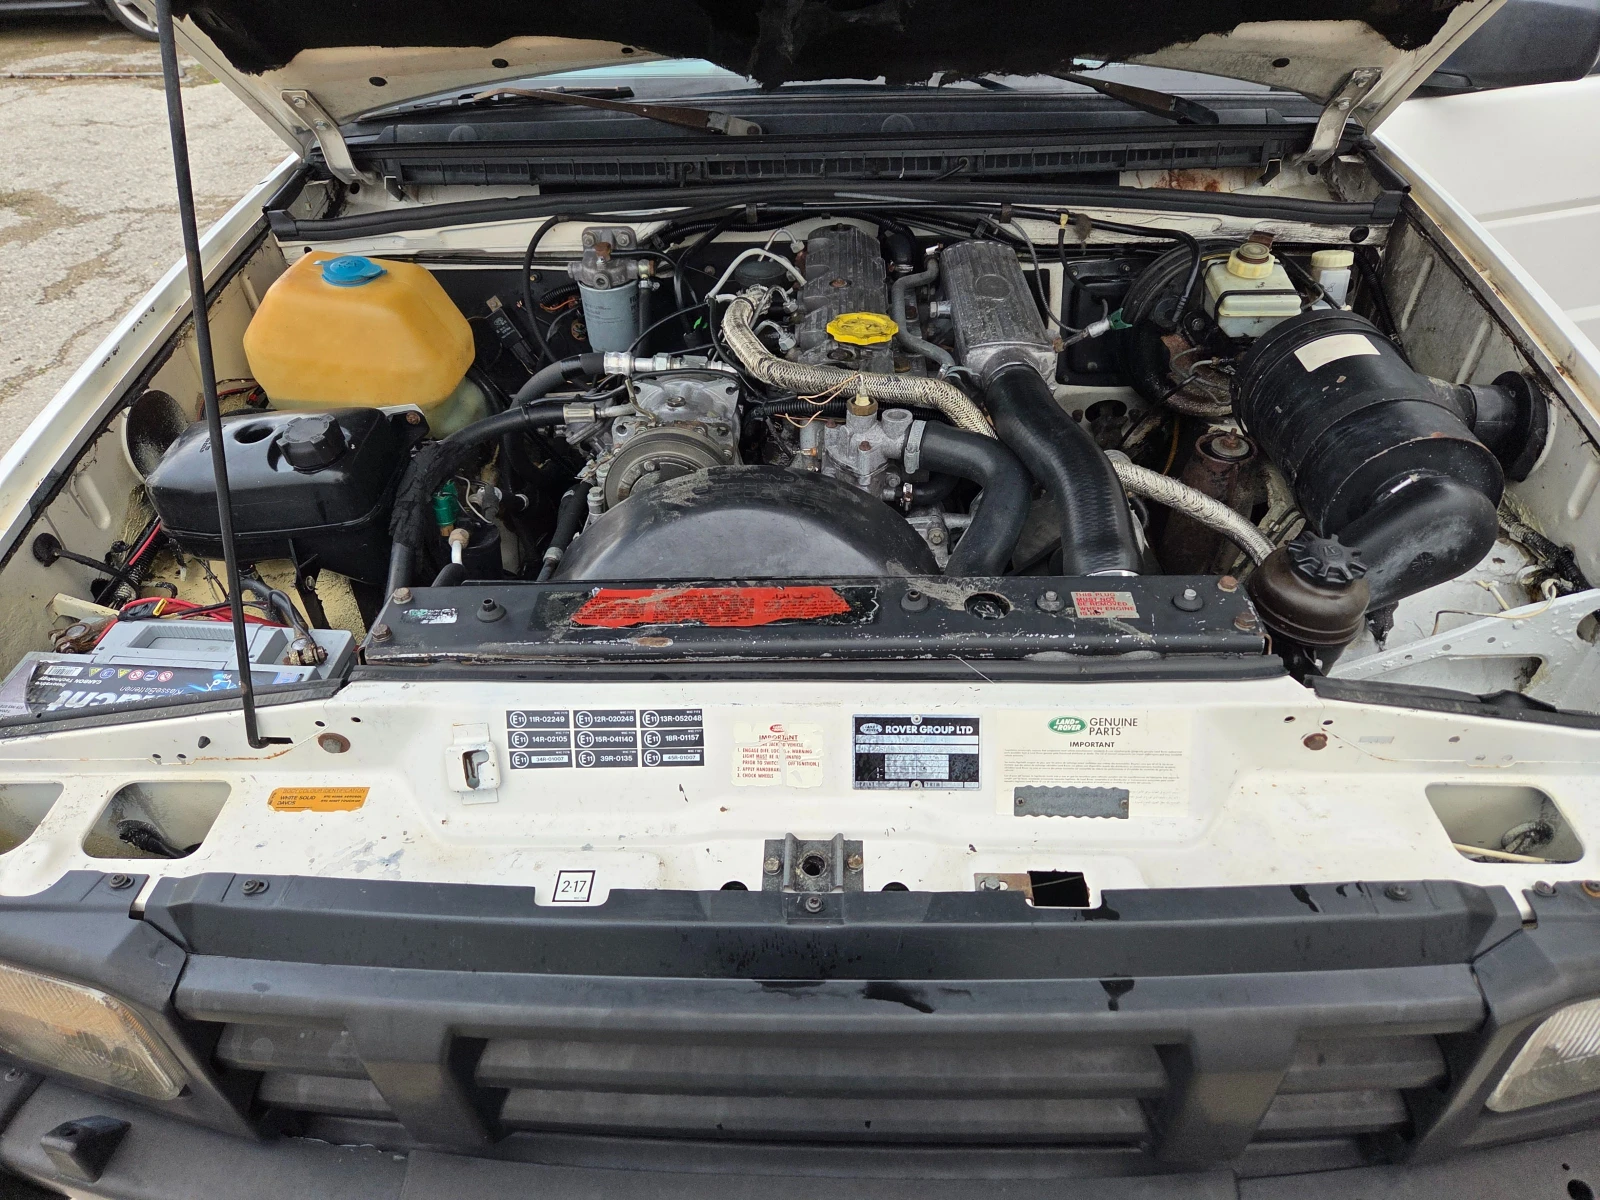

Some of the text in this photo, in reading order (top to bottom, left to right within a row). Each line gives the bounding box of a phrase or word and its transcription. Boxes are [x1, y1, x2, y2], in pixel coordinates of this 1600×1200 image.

[529, 715, 565, 724] 11R-02249
[594, 715, 635, 724] 12R-020248
[660, 714, 703, 723] 13R-052048
[1089, 717, 1138, 727] GENUINE
[885, 725, 973, 734] ROVER GROUP LTD
[1089, 727, 1121, 736] PARTS
[532, 735, 568, 743] 14R-02105
[595, 735, 634, 743] 15R-041140
[600, 755, 633, 763] 39R-0135
